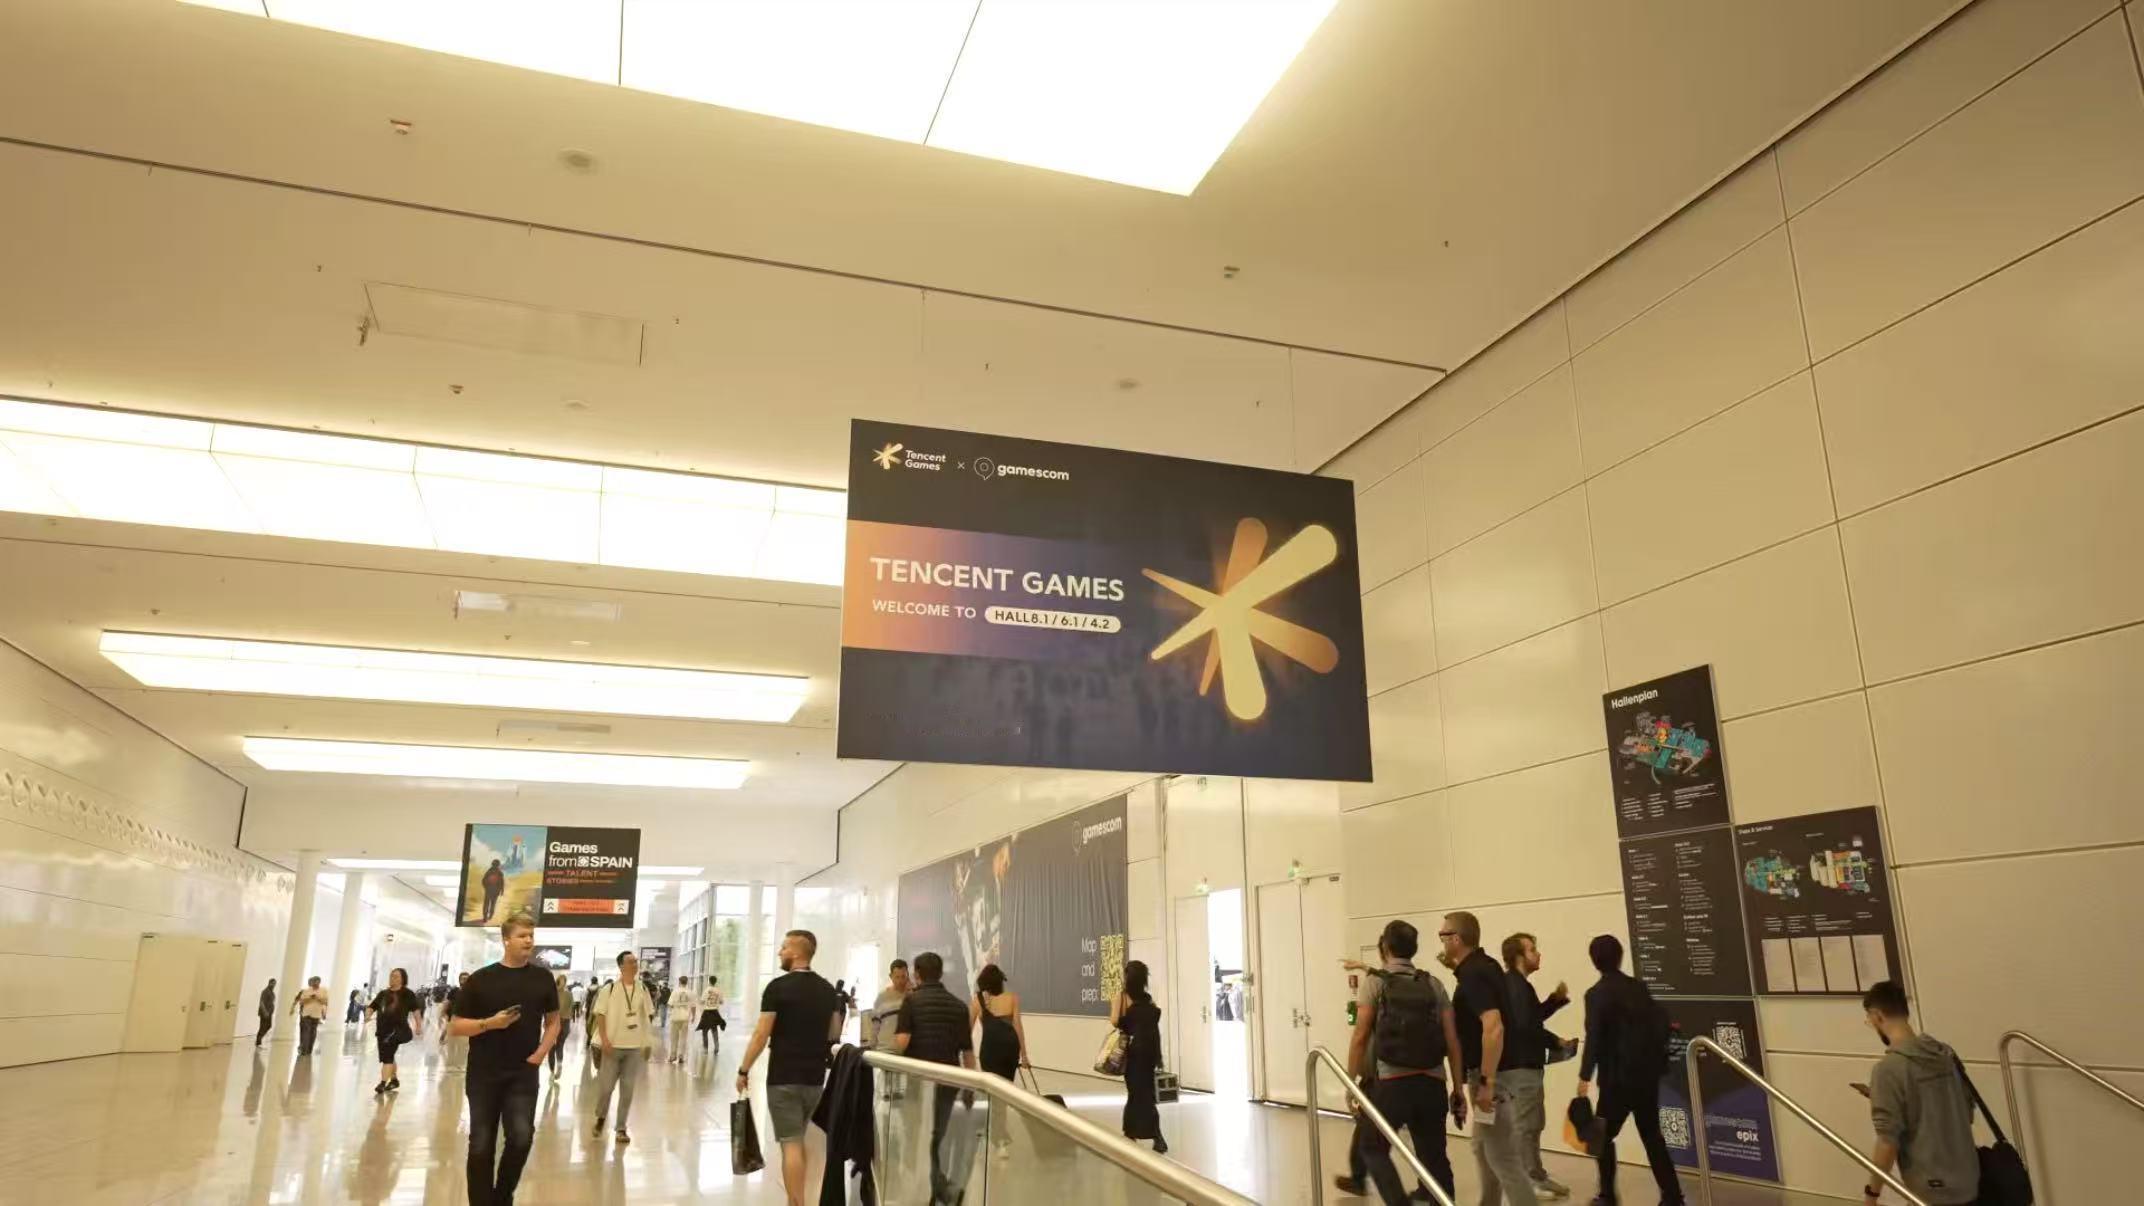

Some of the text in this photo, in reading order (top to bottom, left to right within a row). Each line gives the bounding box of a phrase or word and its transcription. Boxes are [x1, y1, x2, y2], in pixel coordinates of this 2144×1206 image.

[904, 449, 947, 463] Tencent
[904, 459, 941, 472] Games
[997, 464, 1070, 481] gamescom
[869, 556, 1126, 602] TENCENT GAMES
[872, 599, 977, 620] WELCOME TO
[1611, 688, 1659, 710] Hallenplan
[1082, 816, 1122, 845] gamescom
[549, 841, 598, 854] Games
[548, 854, 633, 869] from SPAIN
[1735, 1130, 1759, 1143] epix
